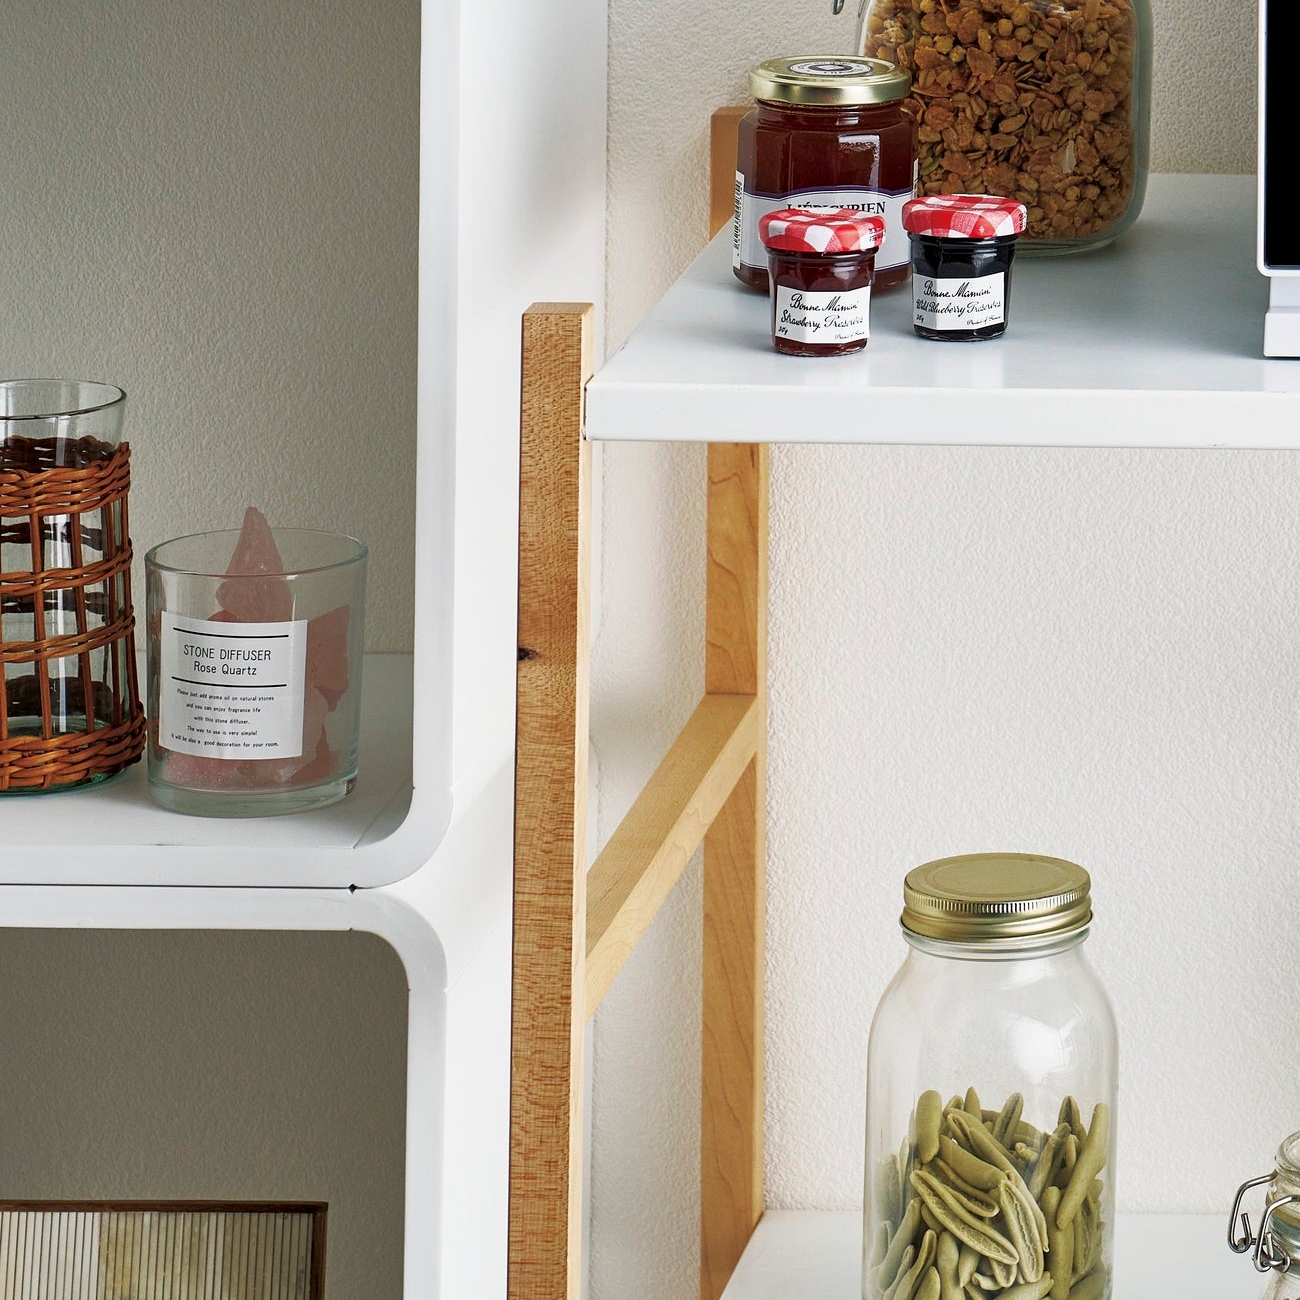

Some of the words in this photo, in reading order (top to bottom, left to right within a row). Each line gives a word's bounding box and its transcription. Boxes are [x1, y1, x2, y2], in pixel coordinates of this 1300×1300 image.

[924, 279, 951, 298] Bonne
[789, 292, 820, 311] Bonne
[780, 309, 821, 333] Strawberry
[183, 644, 215, 659] STONE
[219, 648, 272, 661] DIFFUSER
[193, 660, 217, 674] Rose
[221, 663, 257, 676] Quartz
